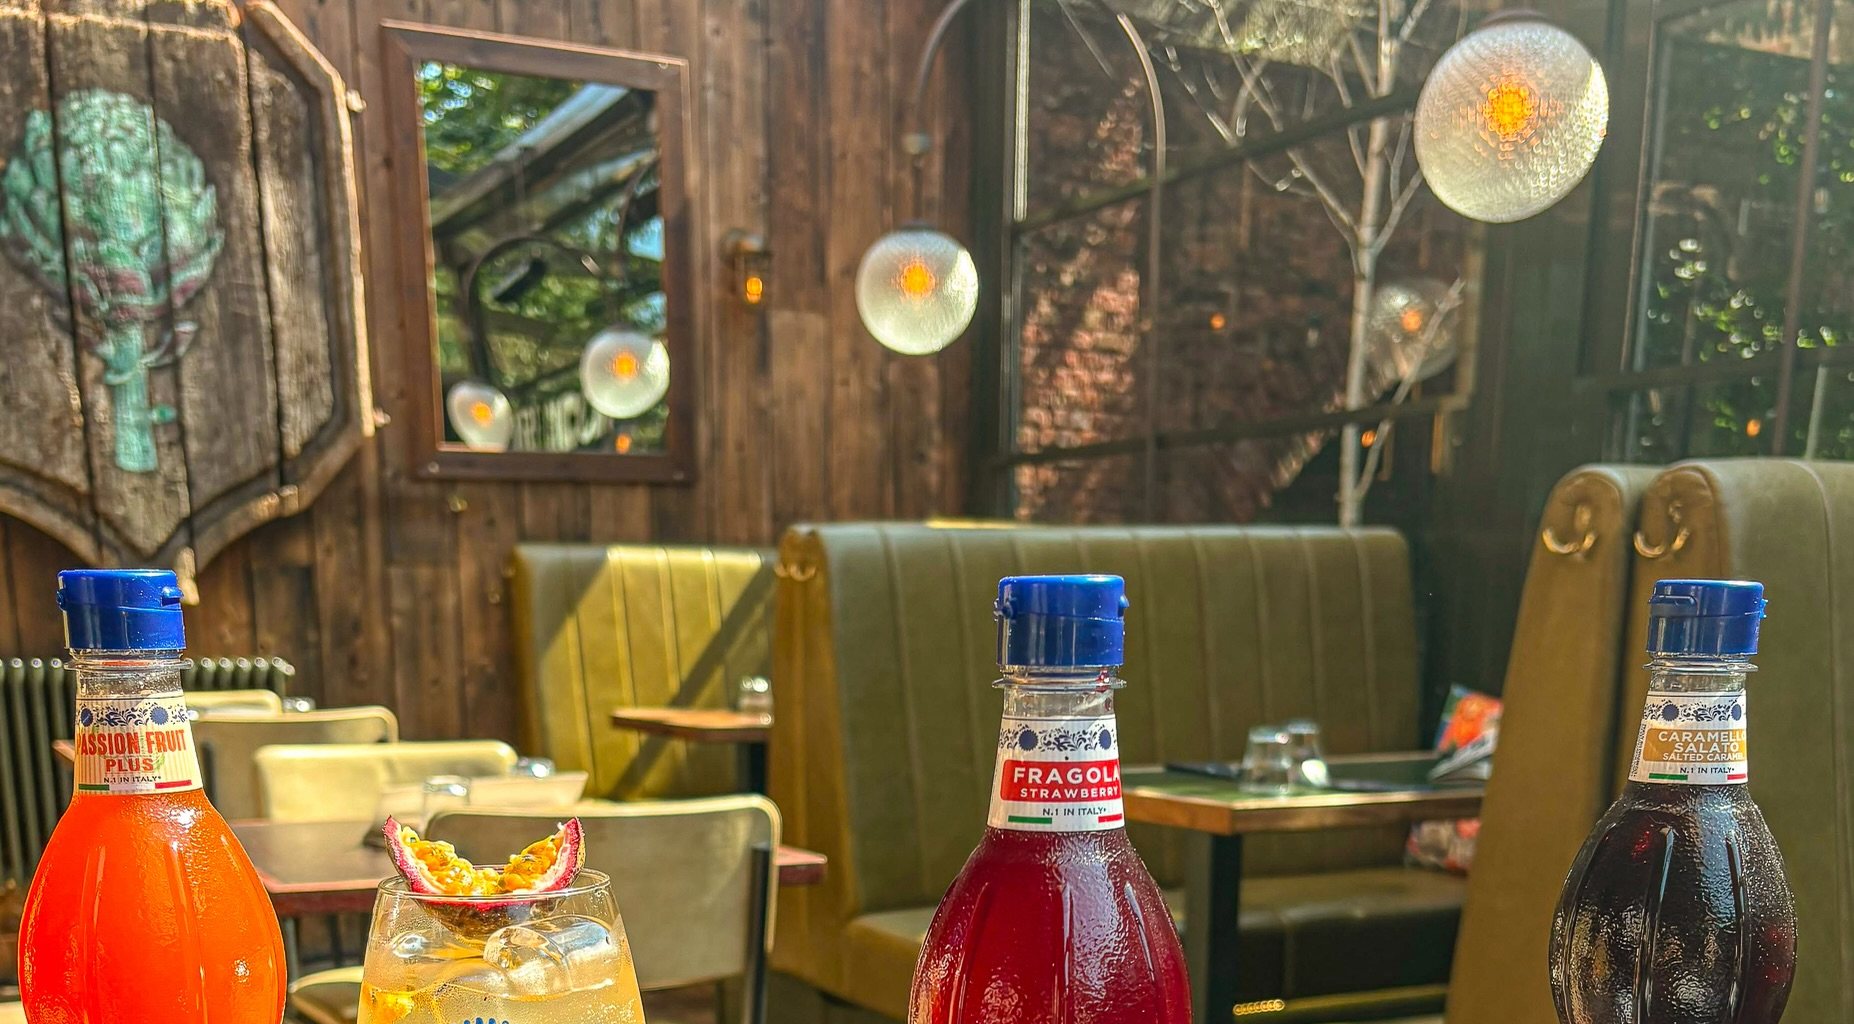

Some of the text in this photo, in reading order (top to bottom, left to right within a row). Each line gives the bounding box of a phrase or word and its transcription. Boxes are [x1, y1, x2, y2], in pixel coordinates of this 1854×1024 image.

[146, 729, 187, 754] FRUIT
[1674, 742, 1739, 753] SALATO
[1663, 753, 1703, 761] SALTED
[105, 758, 154, 772] PLUS
[1013, 765, 1120, 784] FRAGOLA
[1020, 785, 1119, 798] STRAWBERRY
[1042, 808, 1059, 816] N.1
[1064, 808, 1075, 816] IN
